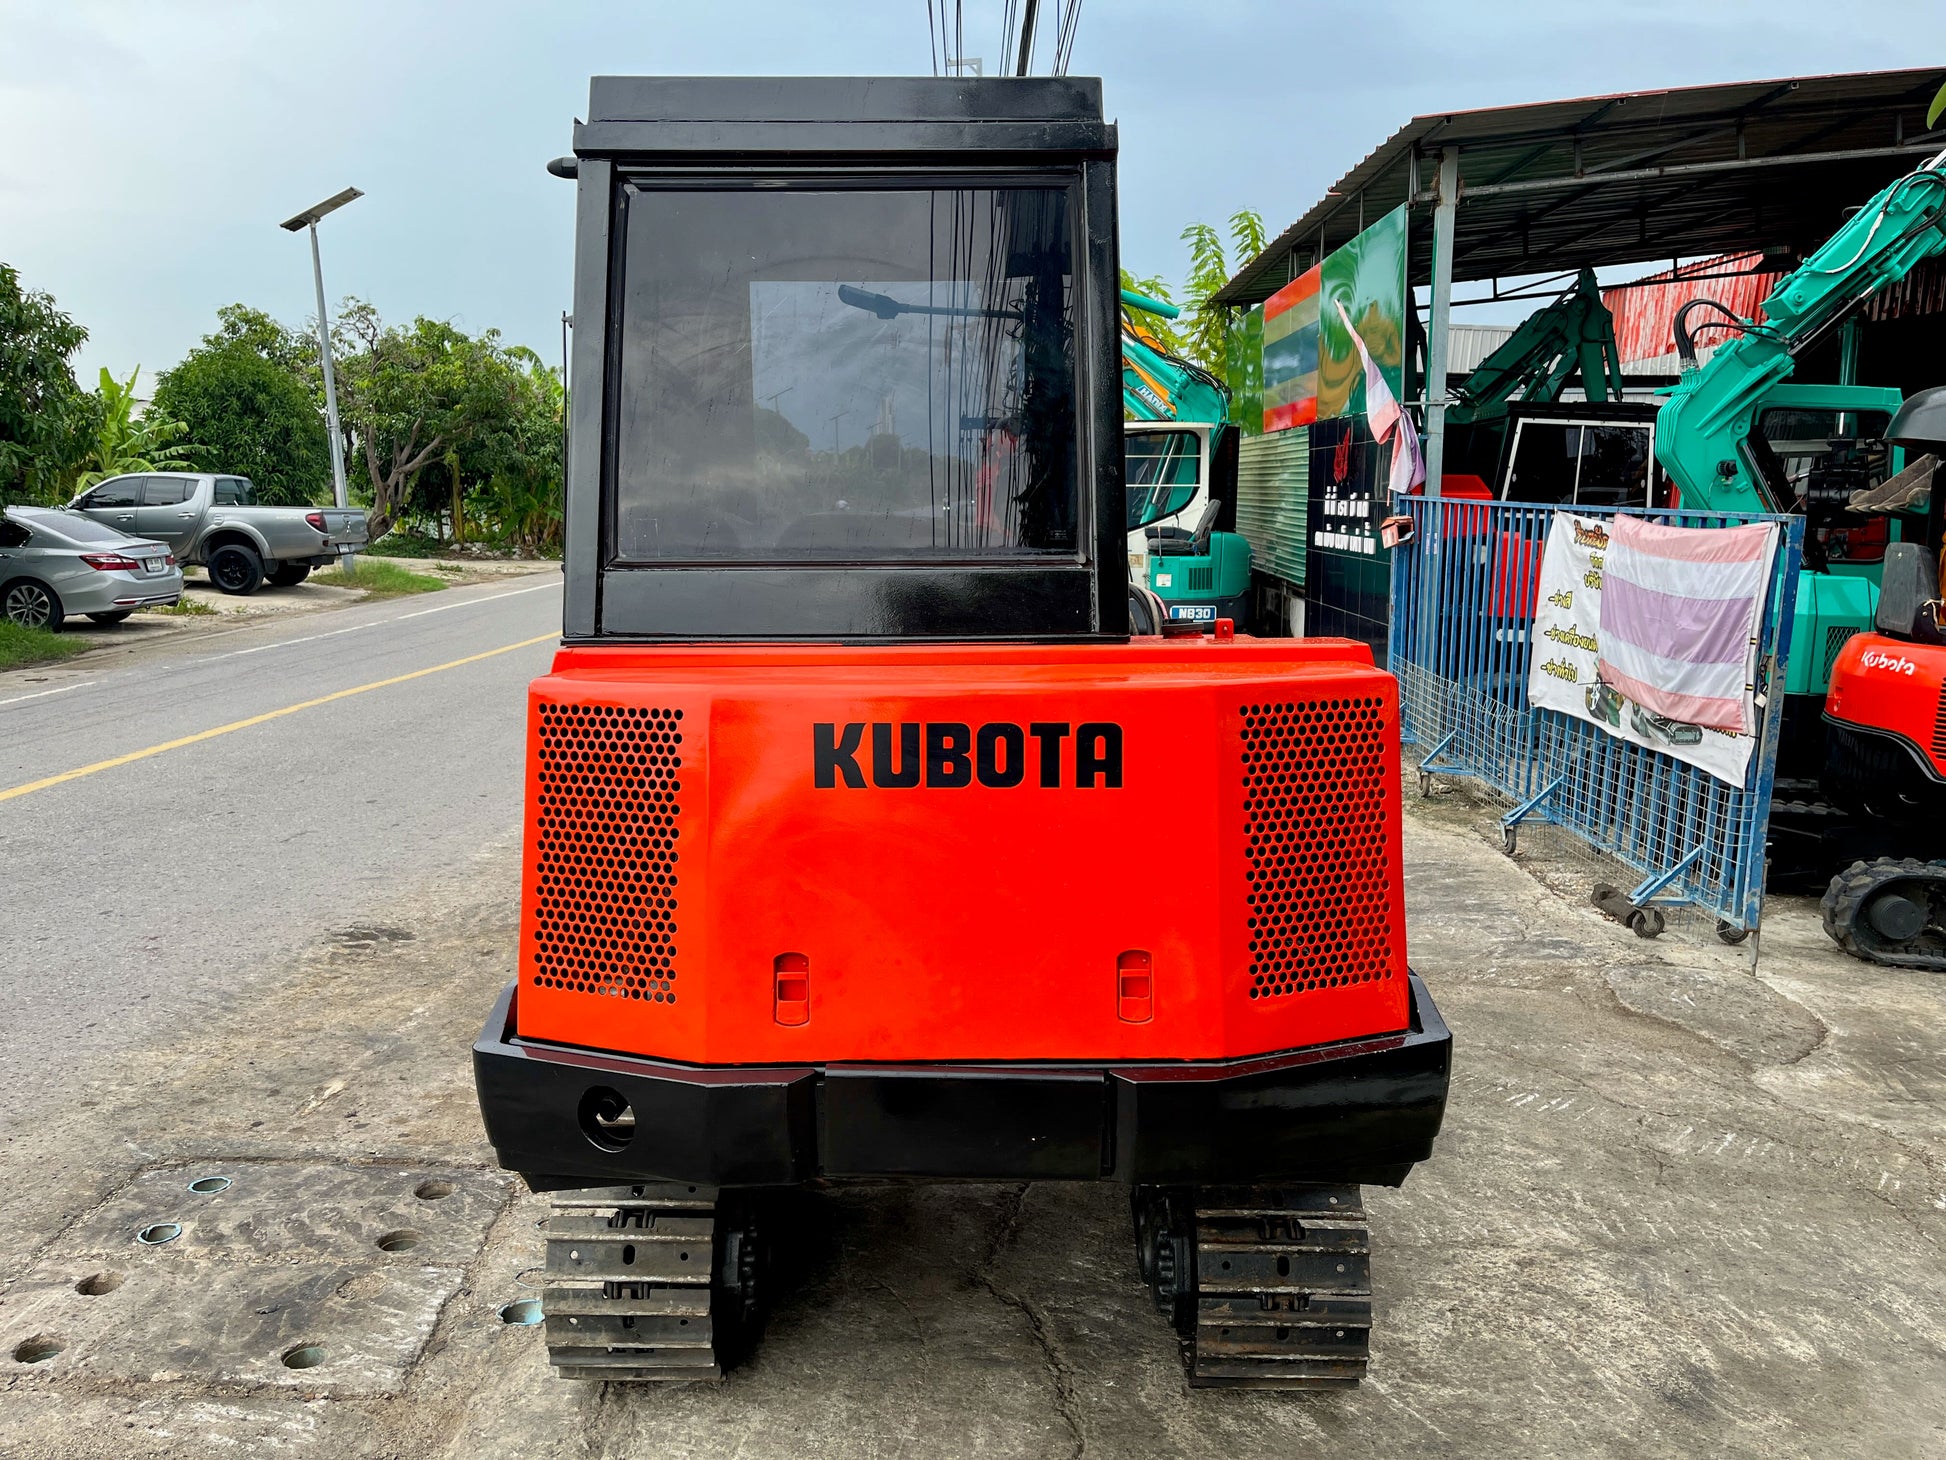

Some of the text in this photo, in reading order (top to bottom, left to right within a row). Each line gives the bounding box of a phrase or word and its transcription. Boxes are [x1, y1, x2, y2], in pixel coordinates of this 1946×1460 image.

[1179, 609, 1211, 619] NB30
[1861, 651, 1915, 676] Kubota
[813, 723, 1123, 789] KUBOTA
